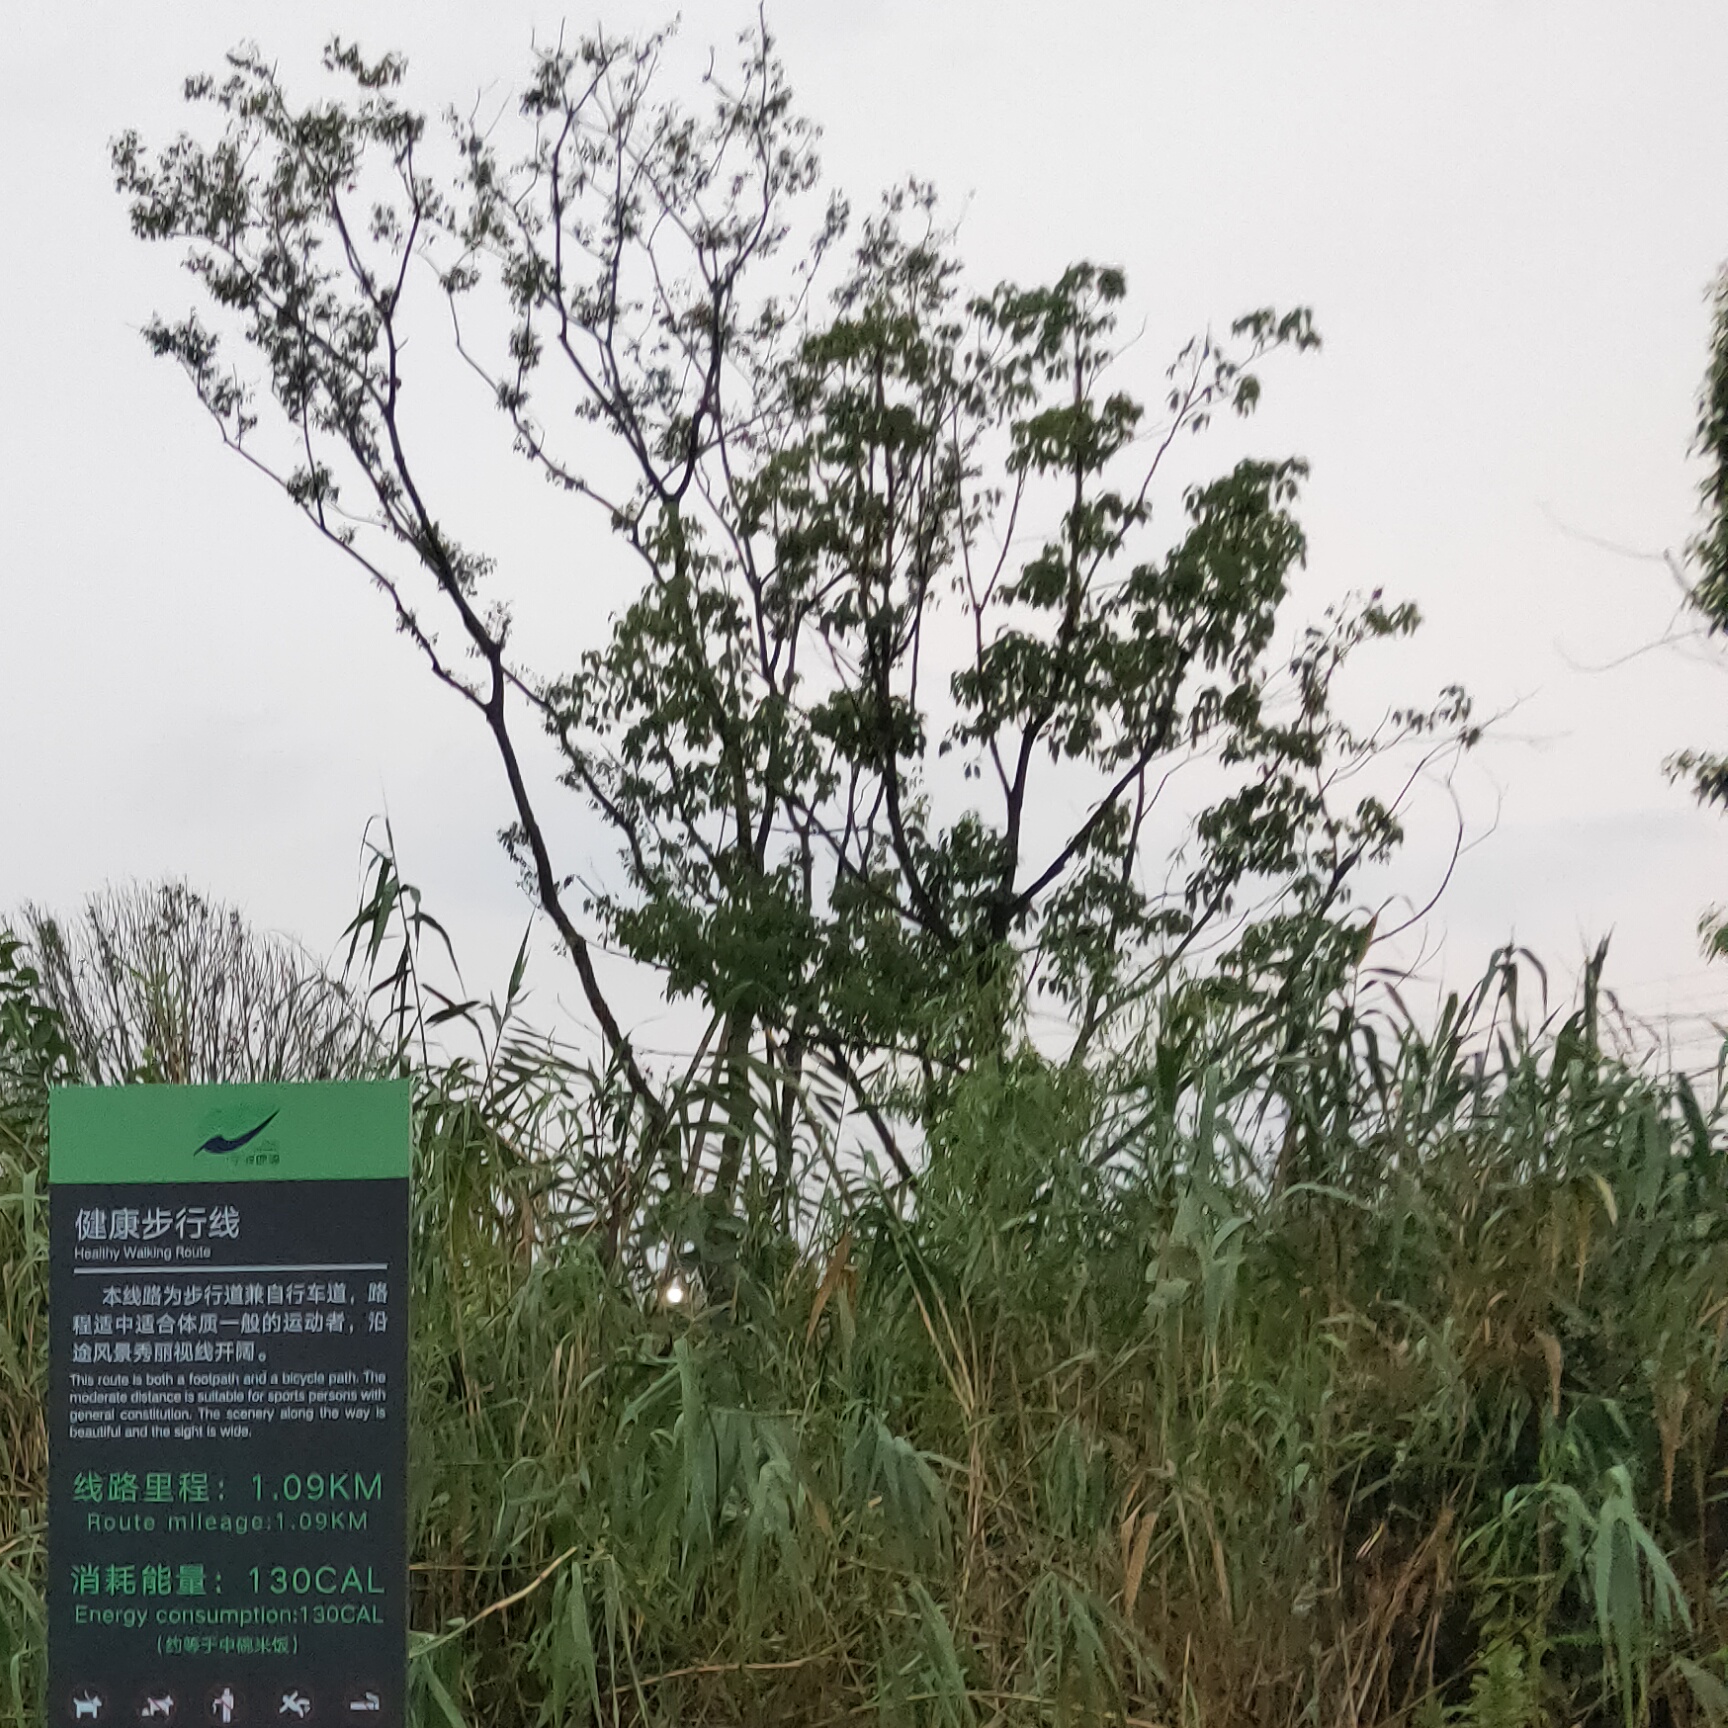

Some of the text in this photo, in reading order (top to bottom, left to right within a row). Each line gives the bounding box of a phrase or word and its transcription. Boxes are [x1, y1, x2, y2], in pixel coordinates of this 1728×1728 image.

[76, 1207, 239, 1239] 健康步行线
[74, 1245, 211, 1261] Healthy Walking Route
[70, 1374, 93, 1386] This
[98, 1374, 129, 1386] route
[146, 1373, 173, 1386] both
[243, 1370, 266, 1385] and
[70, 1391, 127, 1404] moderate
[131, 1391, 181, 1403] distance
[248, 1390, 264, 1402] for
[268, 1390, 305, 1404] sports
[361, 1388, 386, 1401] with
[70, 1408, 115, 1423] general
[198, 1407, 220, 1420] The
[320, 1407, 339, 1419] the
[345, 1407, 370, 1421] way
[125, 1425, 147, 1438] and
[151, 1425, 170, 1437] the
[88, 1512, 155, 1531] Route
[75, 1606, 148, 1628] Energy
